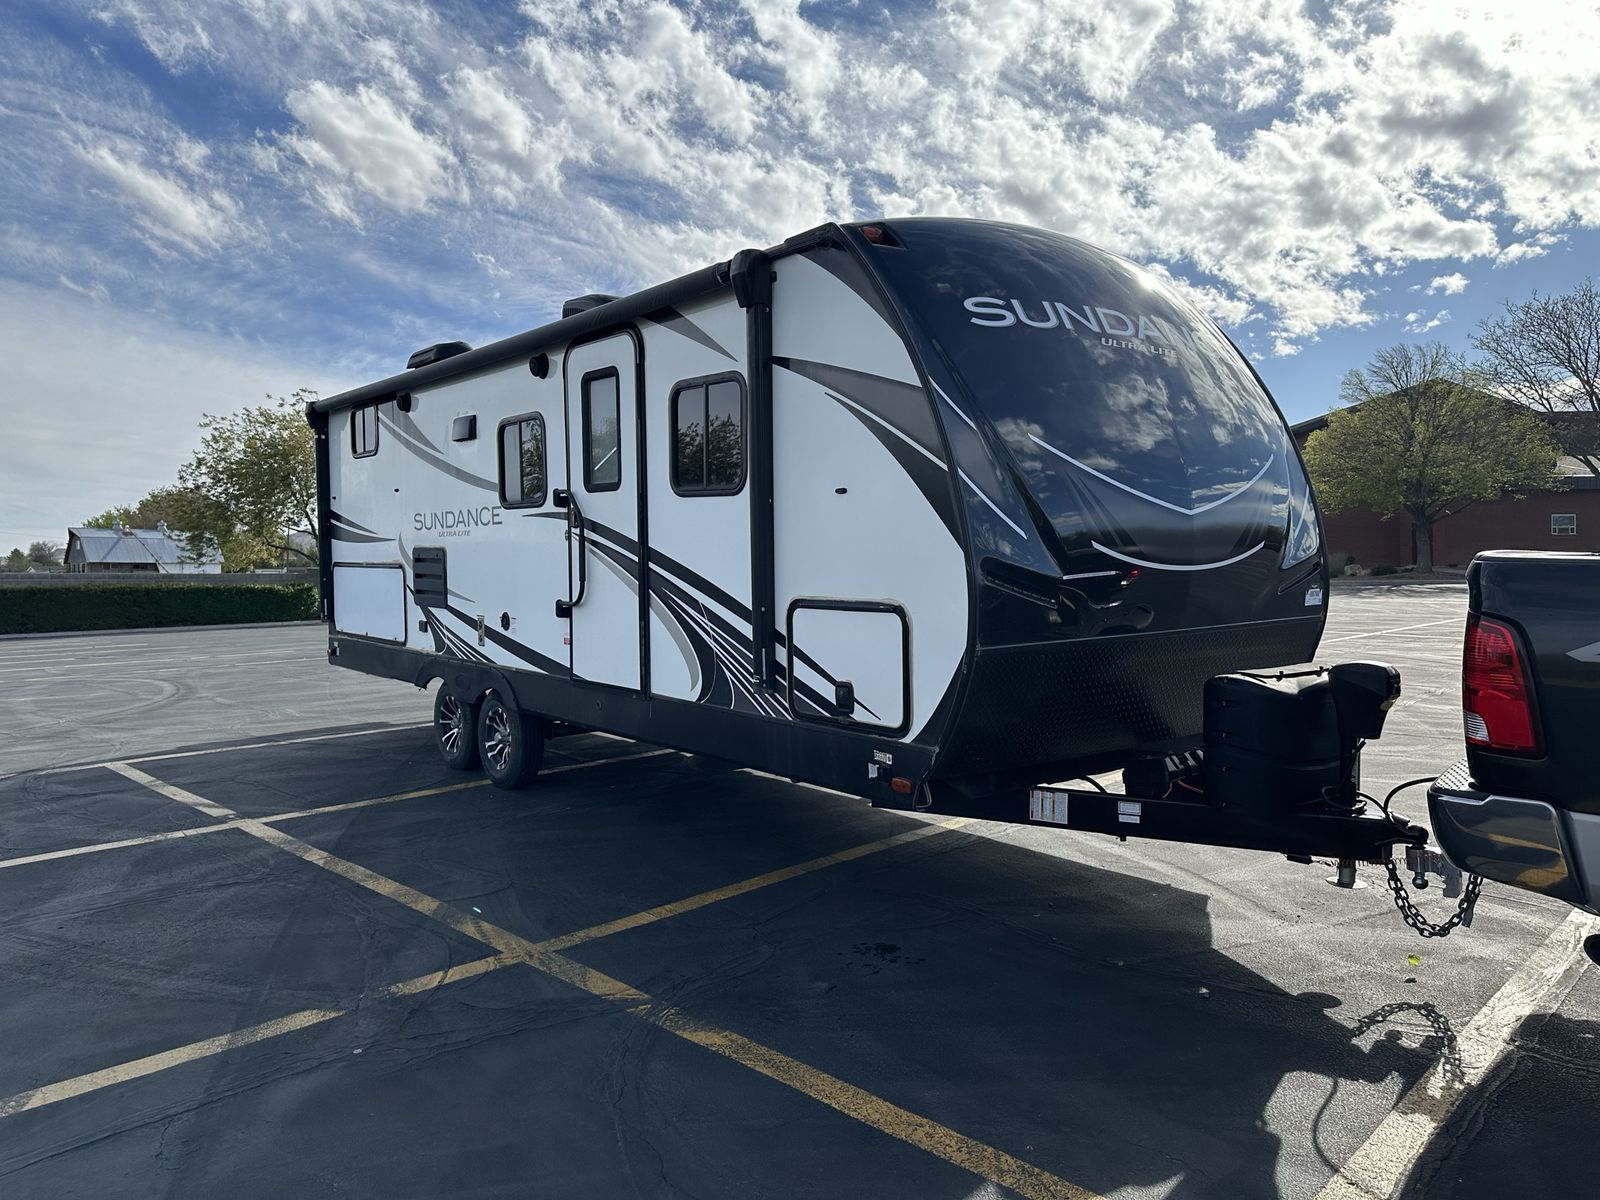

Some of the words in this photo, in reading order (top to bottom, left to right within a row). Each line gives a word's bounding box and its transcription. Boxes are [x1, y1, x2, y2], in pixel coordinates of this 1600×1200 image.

[963, 296, 1208, 352] SUNDAN
[1101, 337, 1150, 353] ULTRA
[1150, 345, 1178, 357] LITE
[413, 506, 503, 531] SUNDANCE
